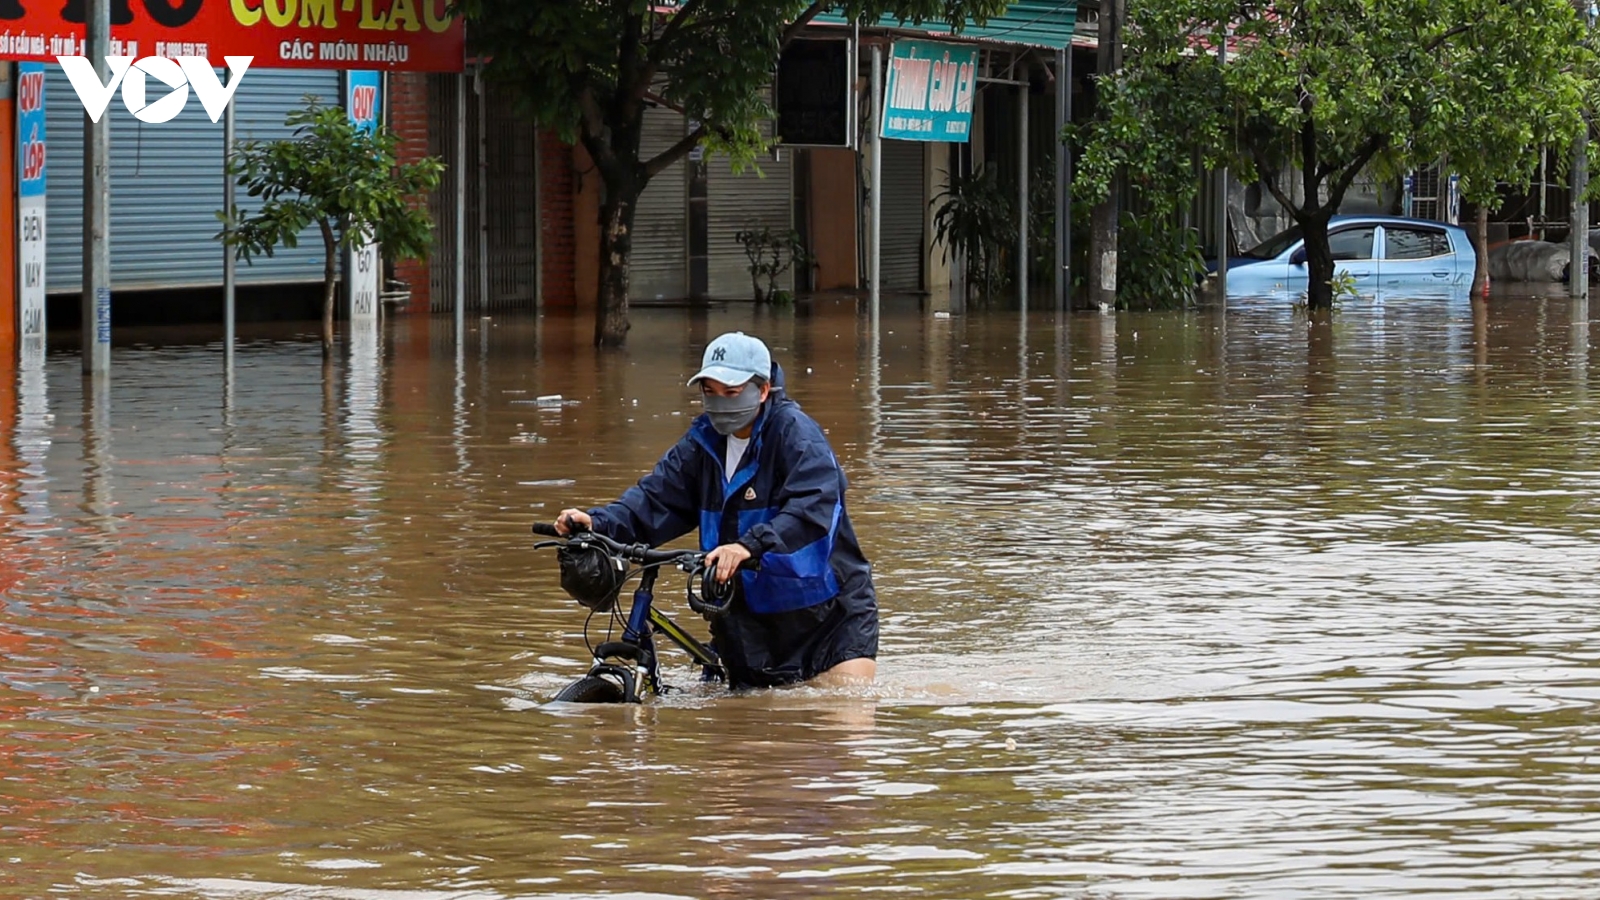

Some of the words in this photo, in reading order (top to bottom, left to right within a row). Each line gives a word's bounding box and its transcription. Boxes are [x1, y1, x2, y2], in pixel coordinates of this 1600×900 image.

[280, 38, 314, 60] CÁC
[319, 39, 358, 61] MÓN
[363, 41, 408, 66] NHẬU
[25, 255, 41, 288] MÁY
